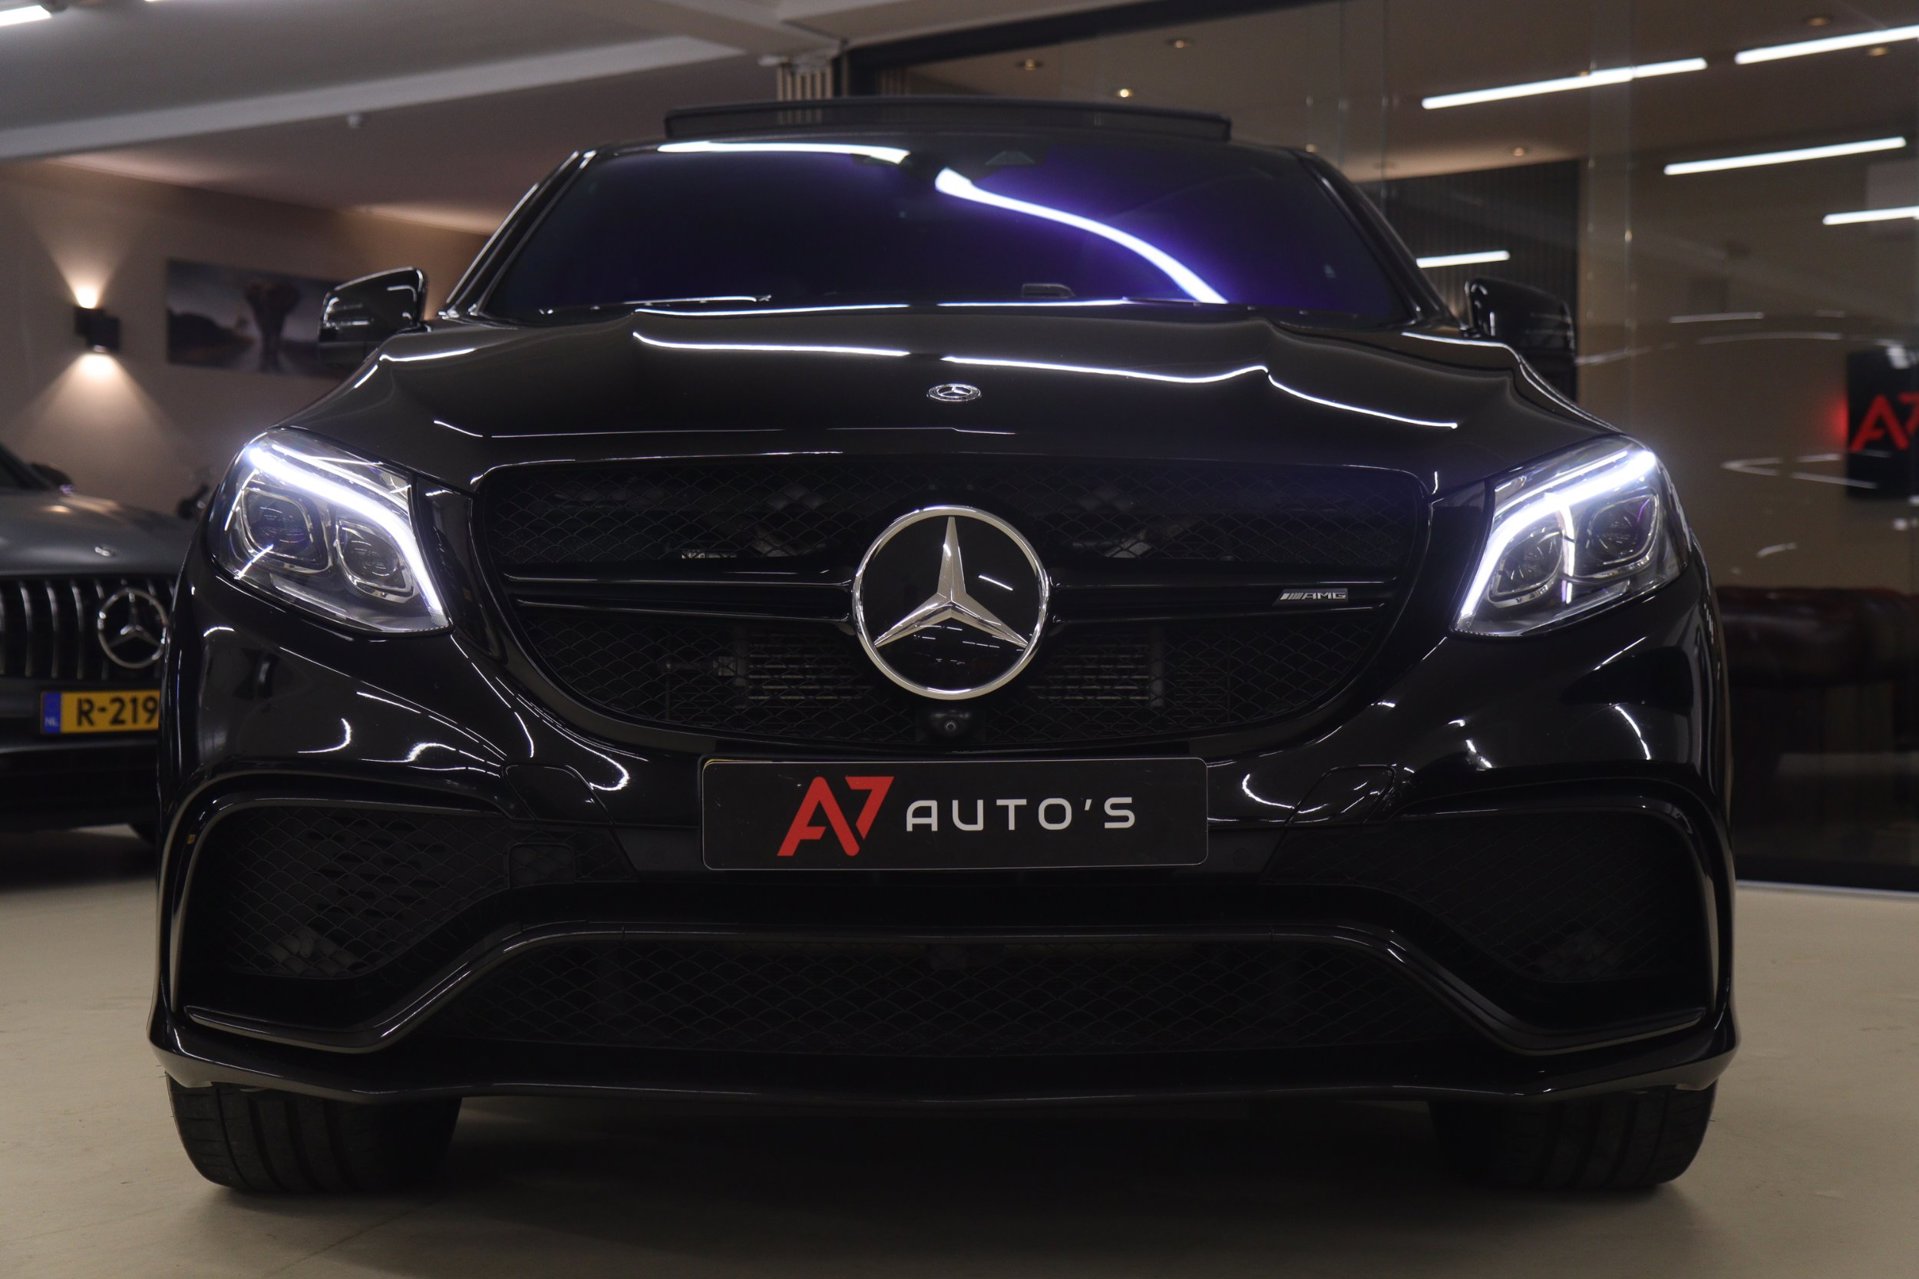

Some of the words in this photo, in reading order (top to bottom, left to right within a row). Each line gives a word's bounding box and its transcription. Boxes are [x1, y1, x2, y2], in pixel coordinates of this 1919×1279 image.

[44, 717, 59, 727] NL
[777, 776, 894, 856] A7
[906, 797, 1135, 832] AUTO'S
